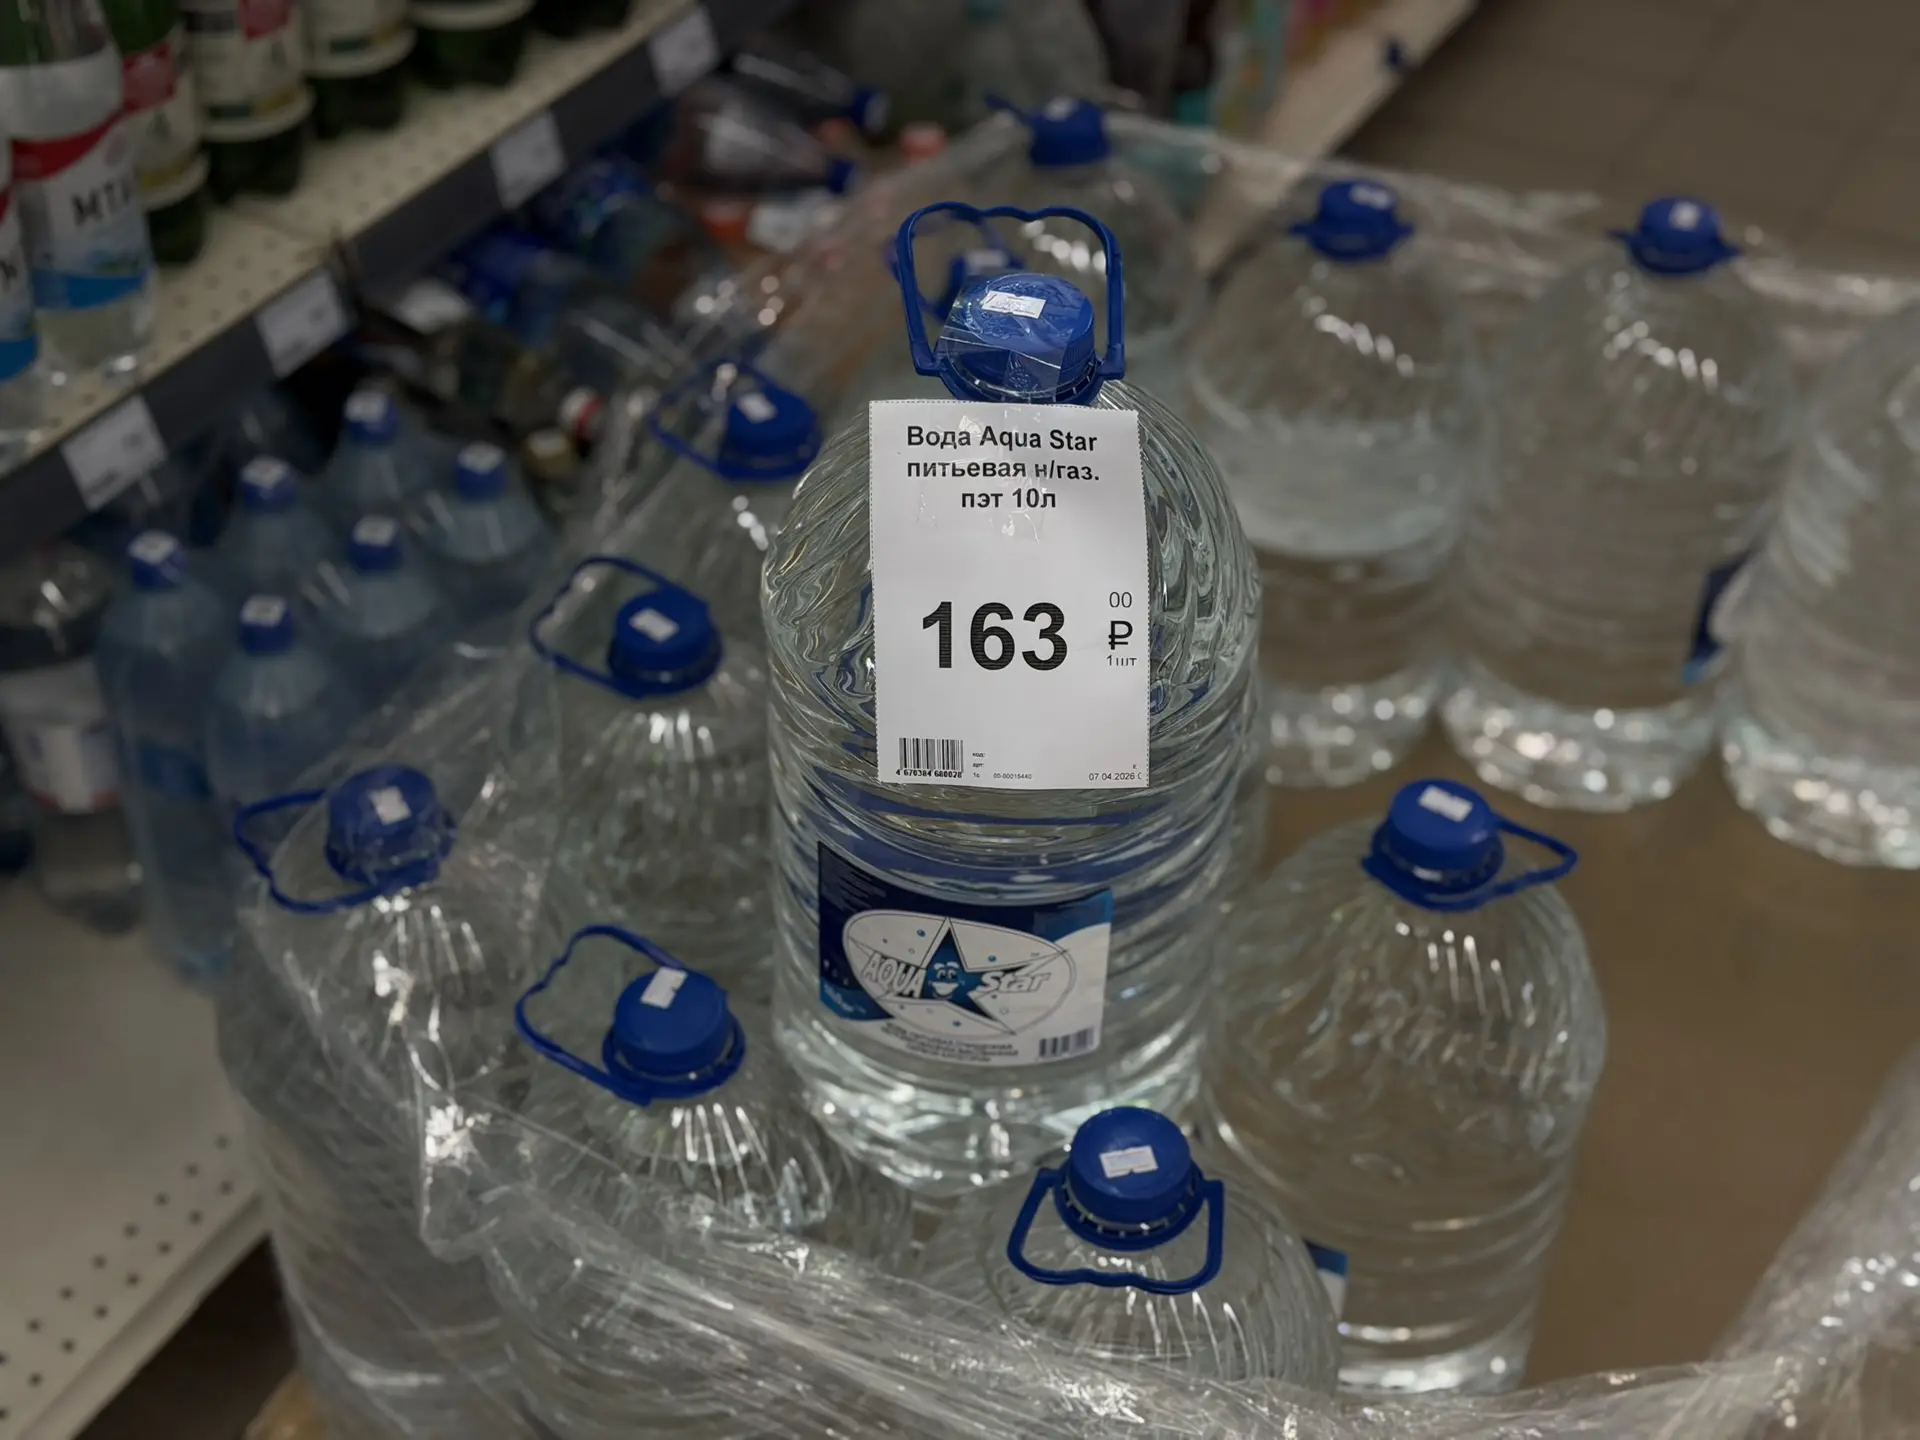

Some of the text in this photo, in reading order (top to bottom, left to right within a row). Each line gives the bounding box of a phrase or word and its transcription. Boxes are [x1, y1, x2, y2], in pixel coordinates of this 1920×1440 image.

[907, 426, 1098, 451] Вода Aqua Star
[907, 460, 1100, 481] питьевая н/газ.
[961, 488, 1056, 508] пэт 10л
[1108, 591, 1133, 608] 00
[922, 601, 1068, 671] 163
[862, 952, 927, 1000] AQUA
[974, 970, 1052, 993] Star
